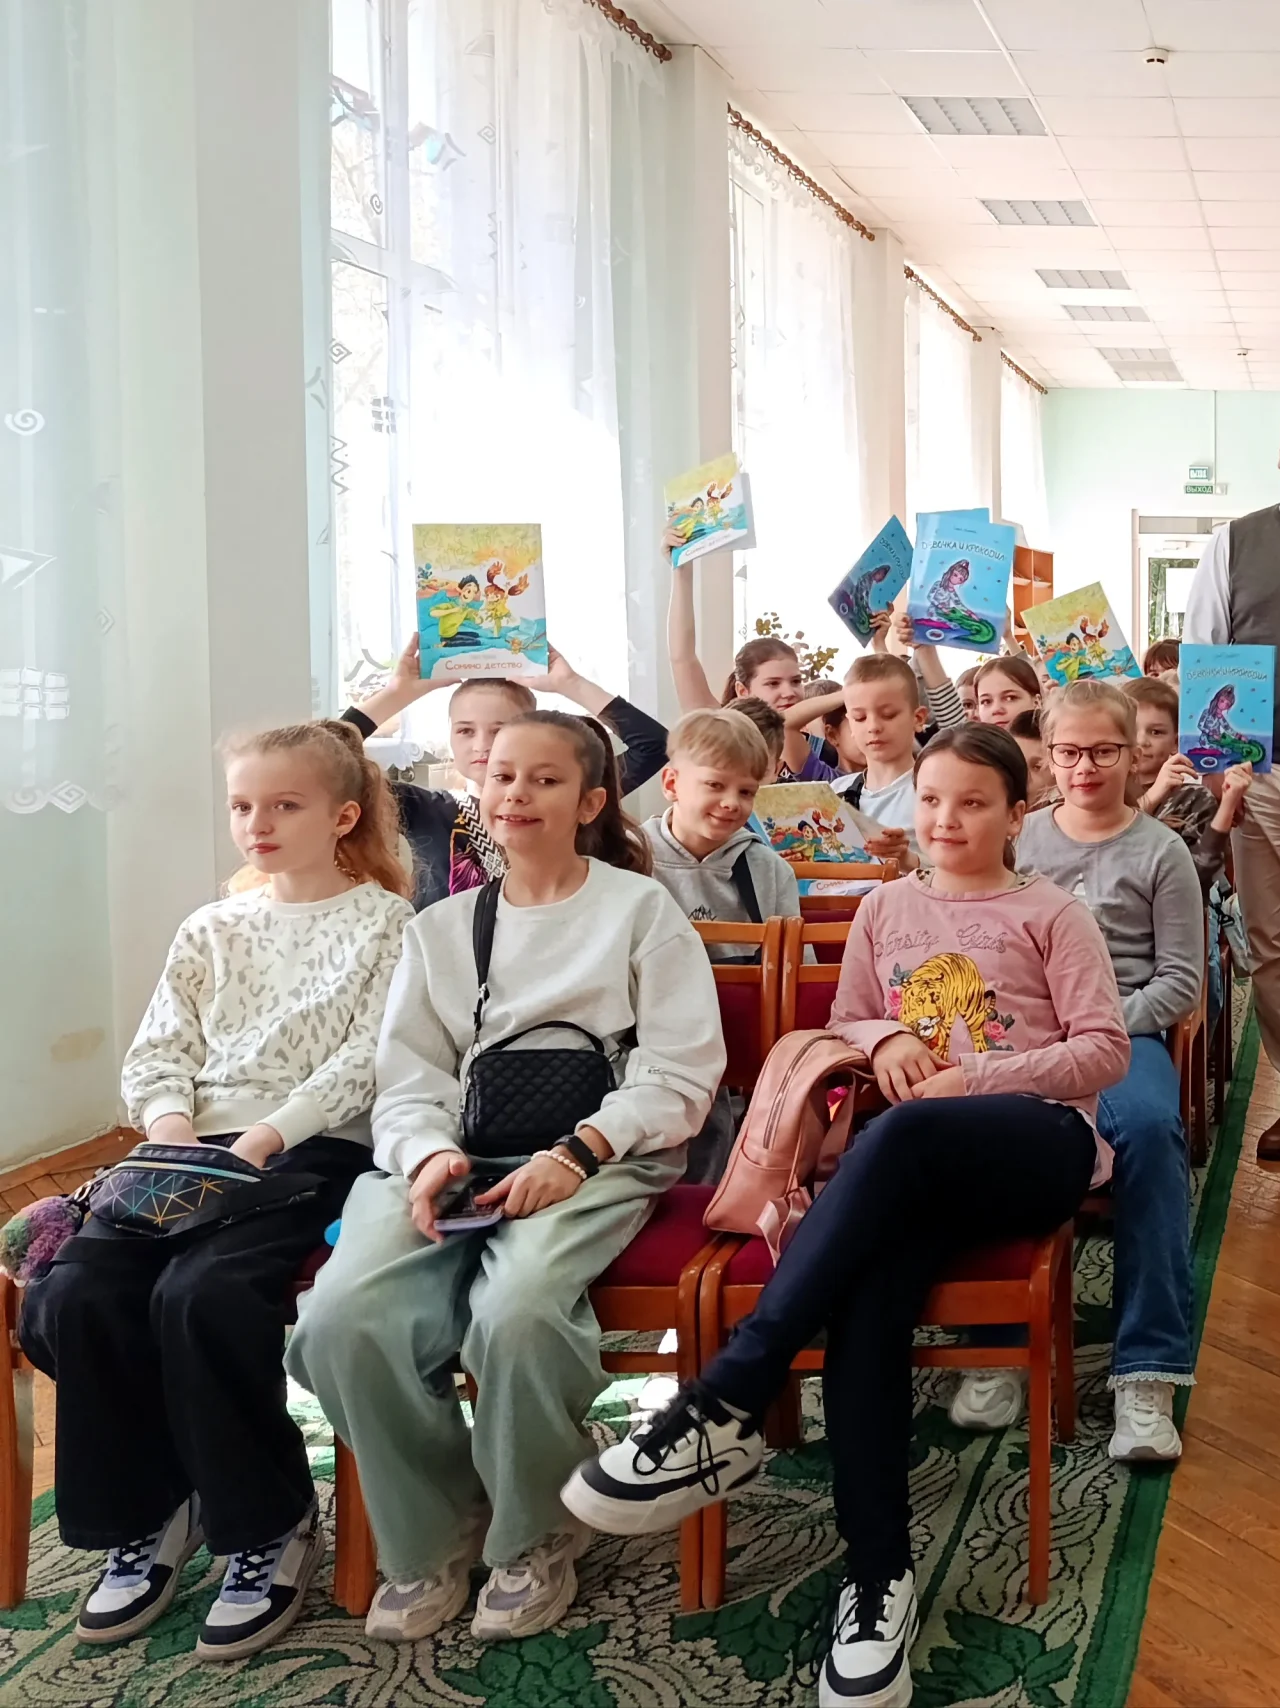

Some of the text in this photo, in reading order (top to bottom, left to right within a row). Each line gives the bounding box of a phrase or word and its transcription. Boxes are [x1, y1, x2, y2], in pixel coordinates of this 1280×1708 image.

[921, 541, 957, 550] ДВОЧКА
[966, 544, 1005, 561] КРОКОДИЛ
[445, 660, 481, 670] Сонино
